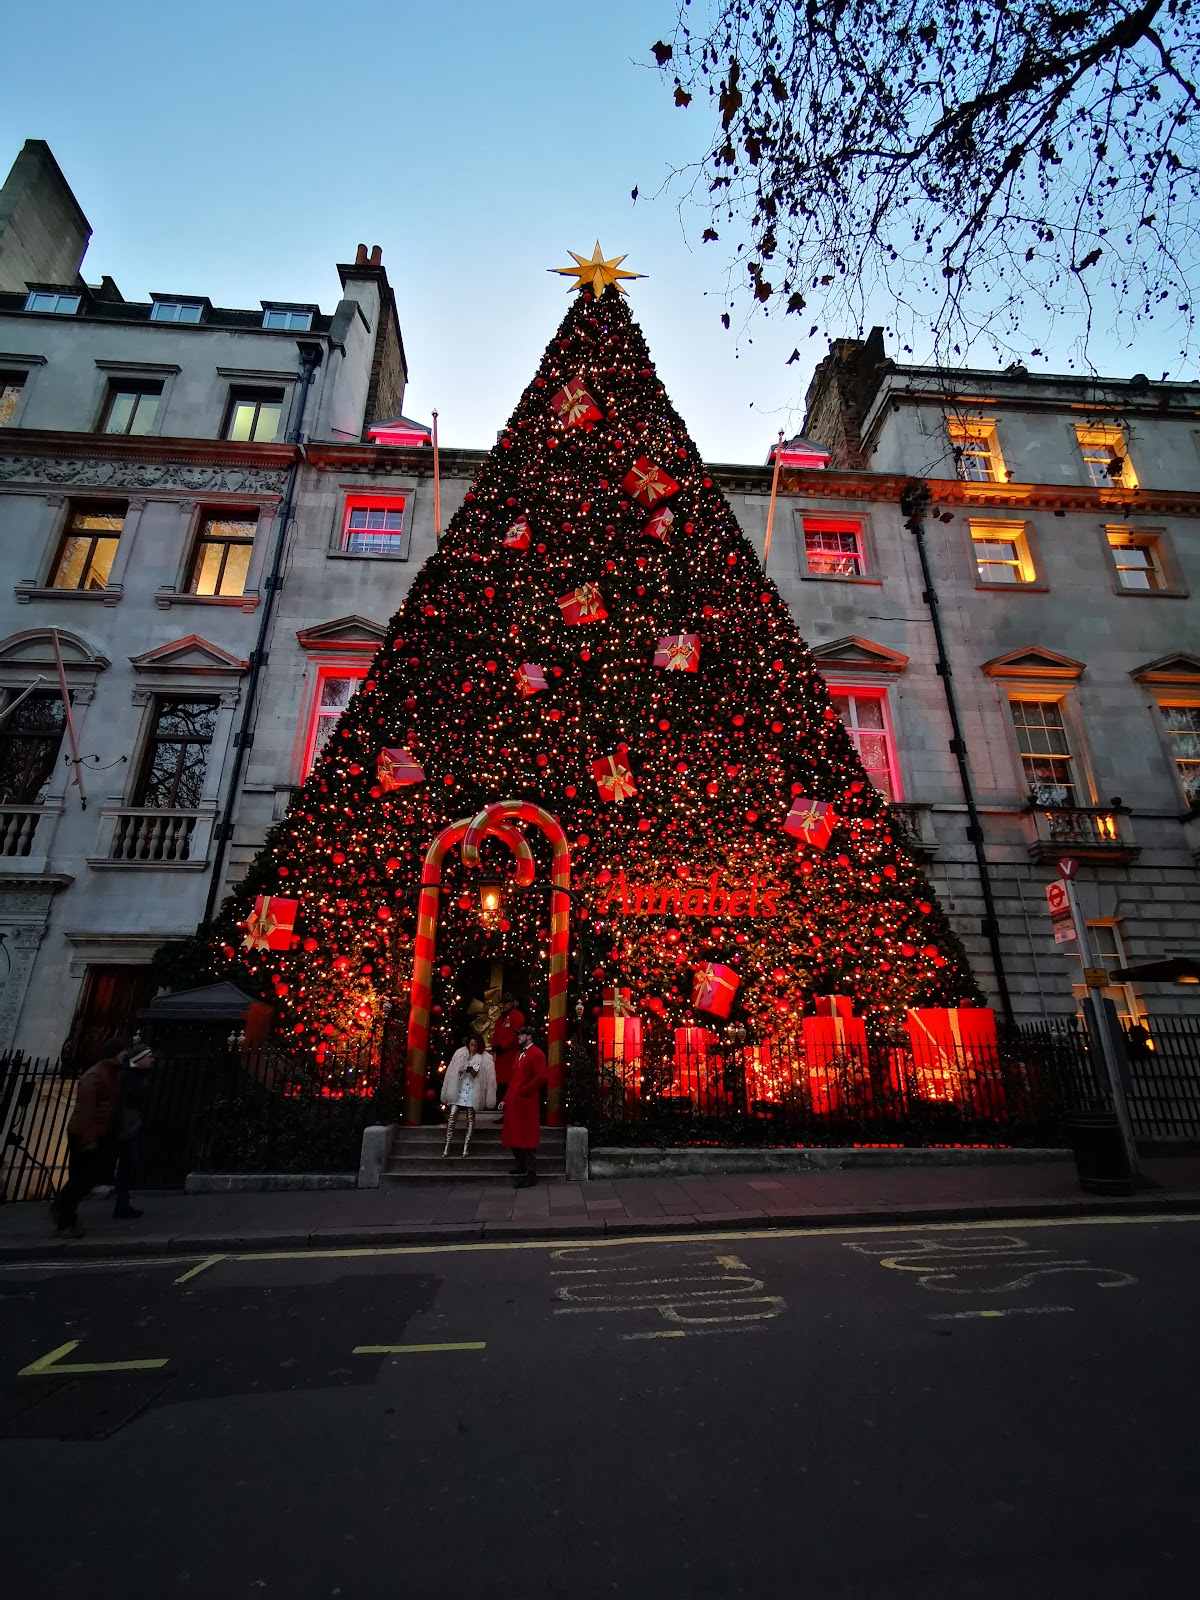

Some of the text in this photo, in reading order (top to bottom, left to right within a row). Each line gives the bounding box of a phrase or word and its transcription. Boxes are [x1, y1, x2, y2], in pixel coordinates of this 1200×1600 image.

[597, 869, 779, 918] Annabel's
[1059, 861, 1072, 875] V
[549, 1241, 788, 1324] STOP
[841, 1235, 1139, 1294] BUS
